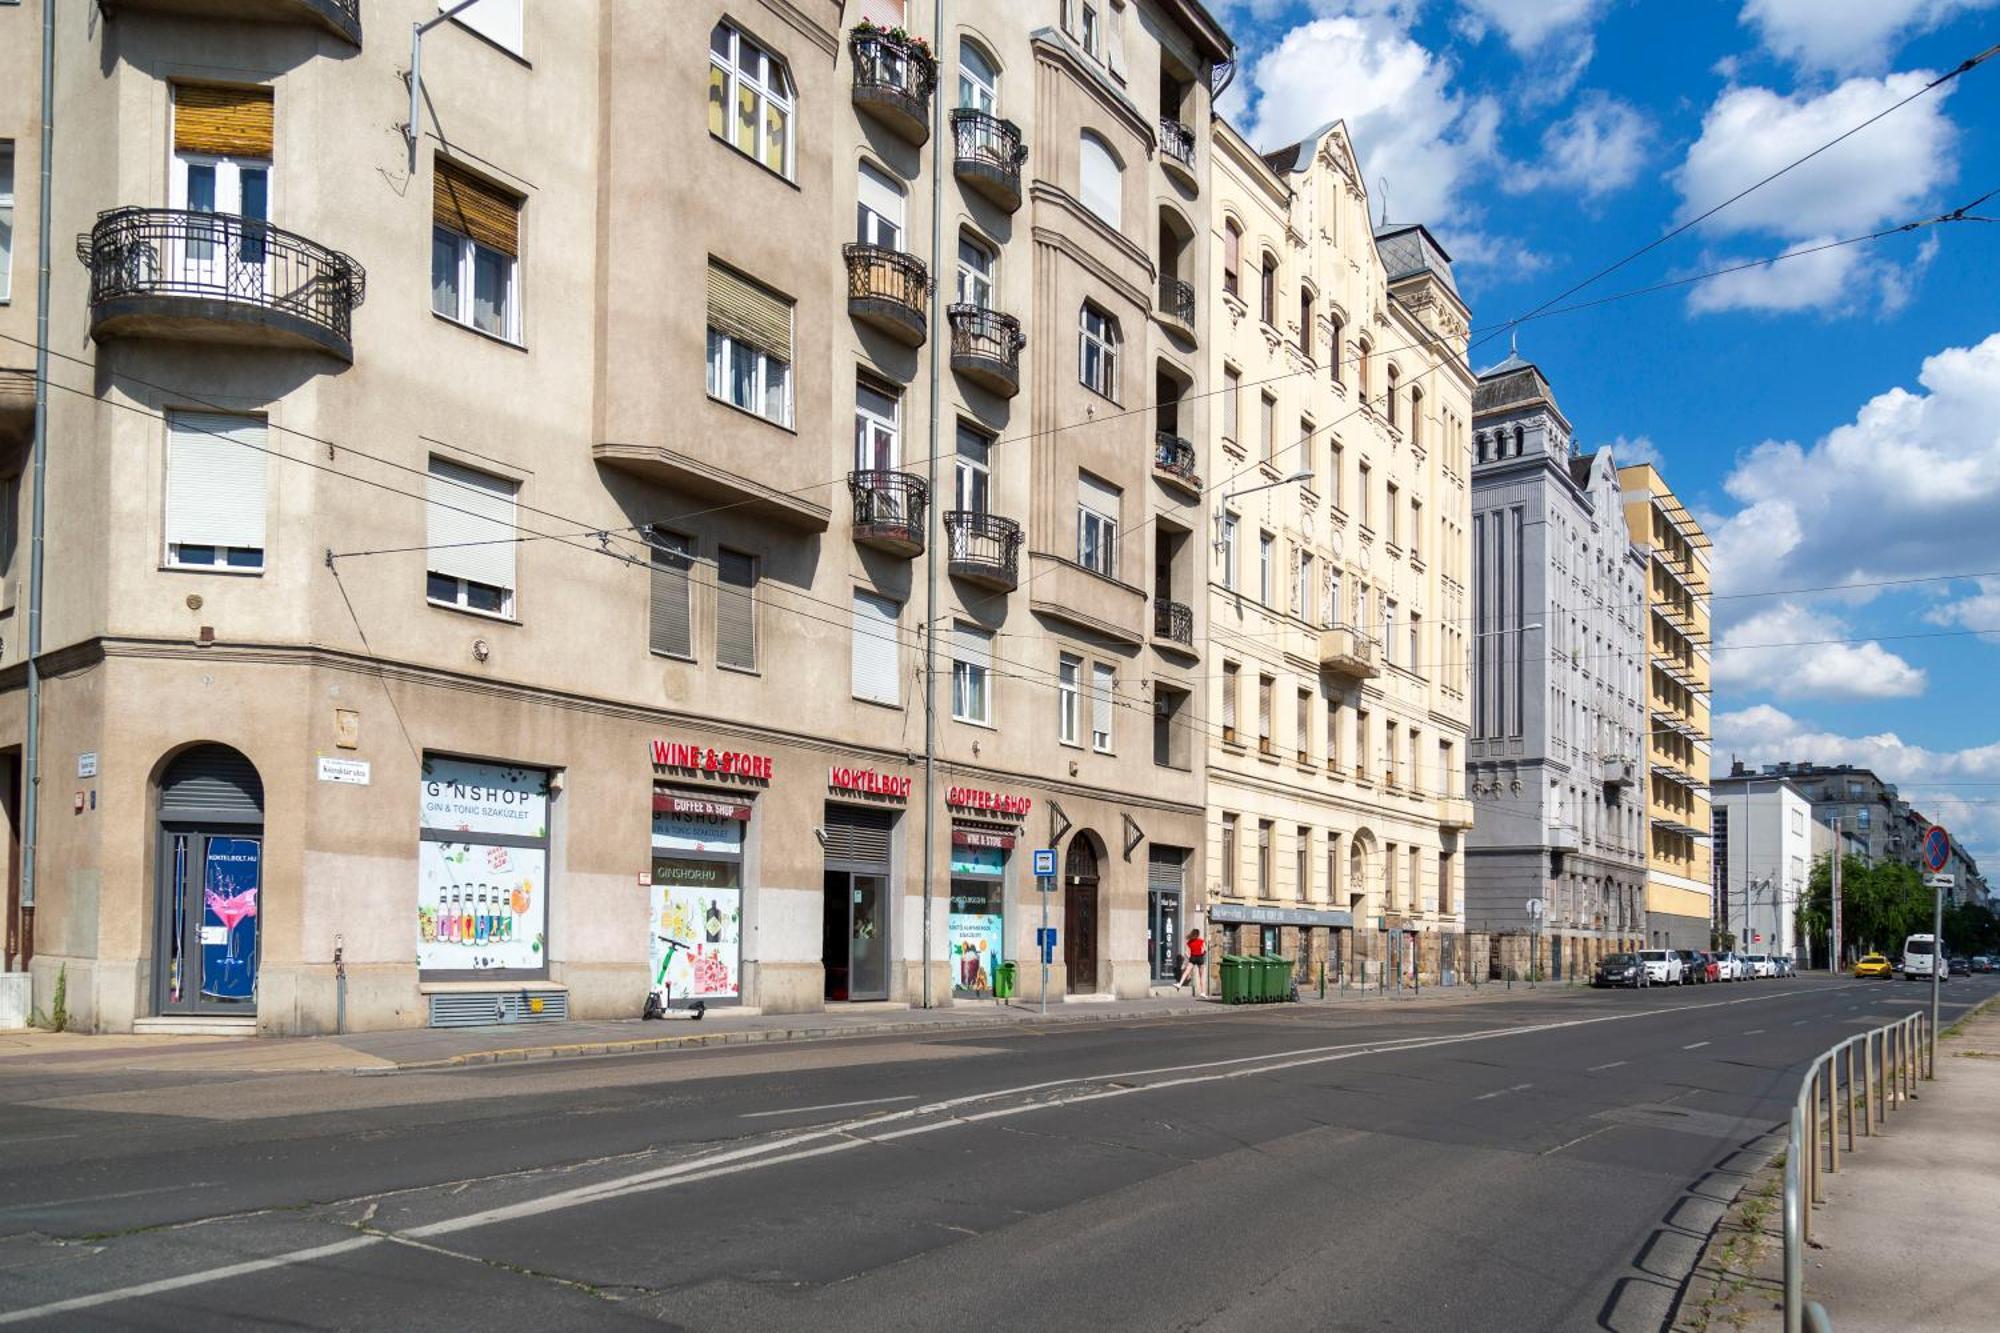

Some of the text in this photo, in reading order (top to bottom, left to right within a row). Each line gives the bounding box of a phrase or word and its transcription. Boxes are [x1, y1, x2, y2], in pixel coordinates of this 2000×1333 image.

[654, 741, 773, 778] WINE & STORE
[427, 781, 529, 805] GNSHOP
[831, 766, 912, 798] KOKTÉLBOLT
[426, 802, 442, 812] GIN
[445, 804, 451, 812] &
[454, 804, 479, 815] TONIC
[674, 799, 734, 817] COFFEE & SHOP
[950, 786, 1032, 815] COFFEE & SHOP
